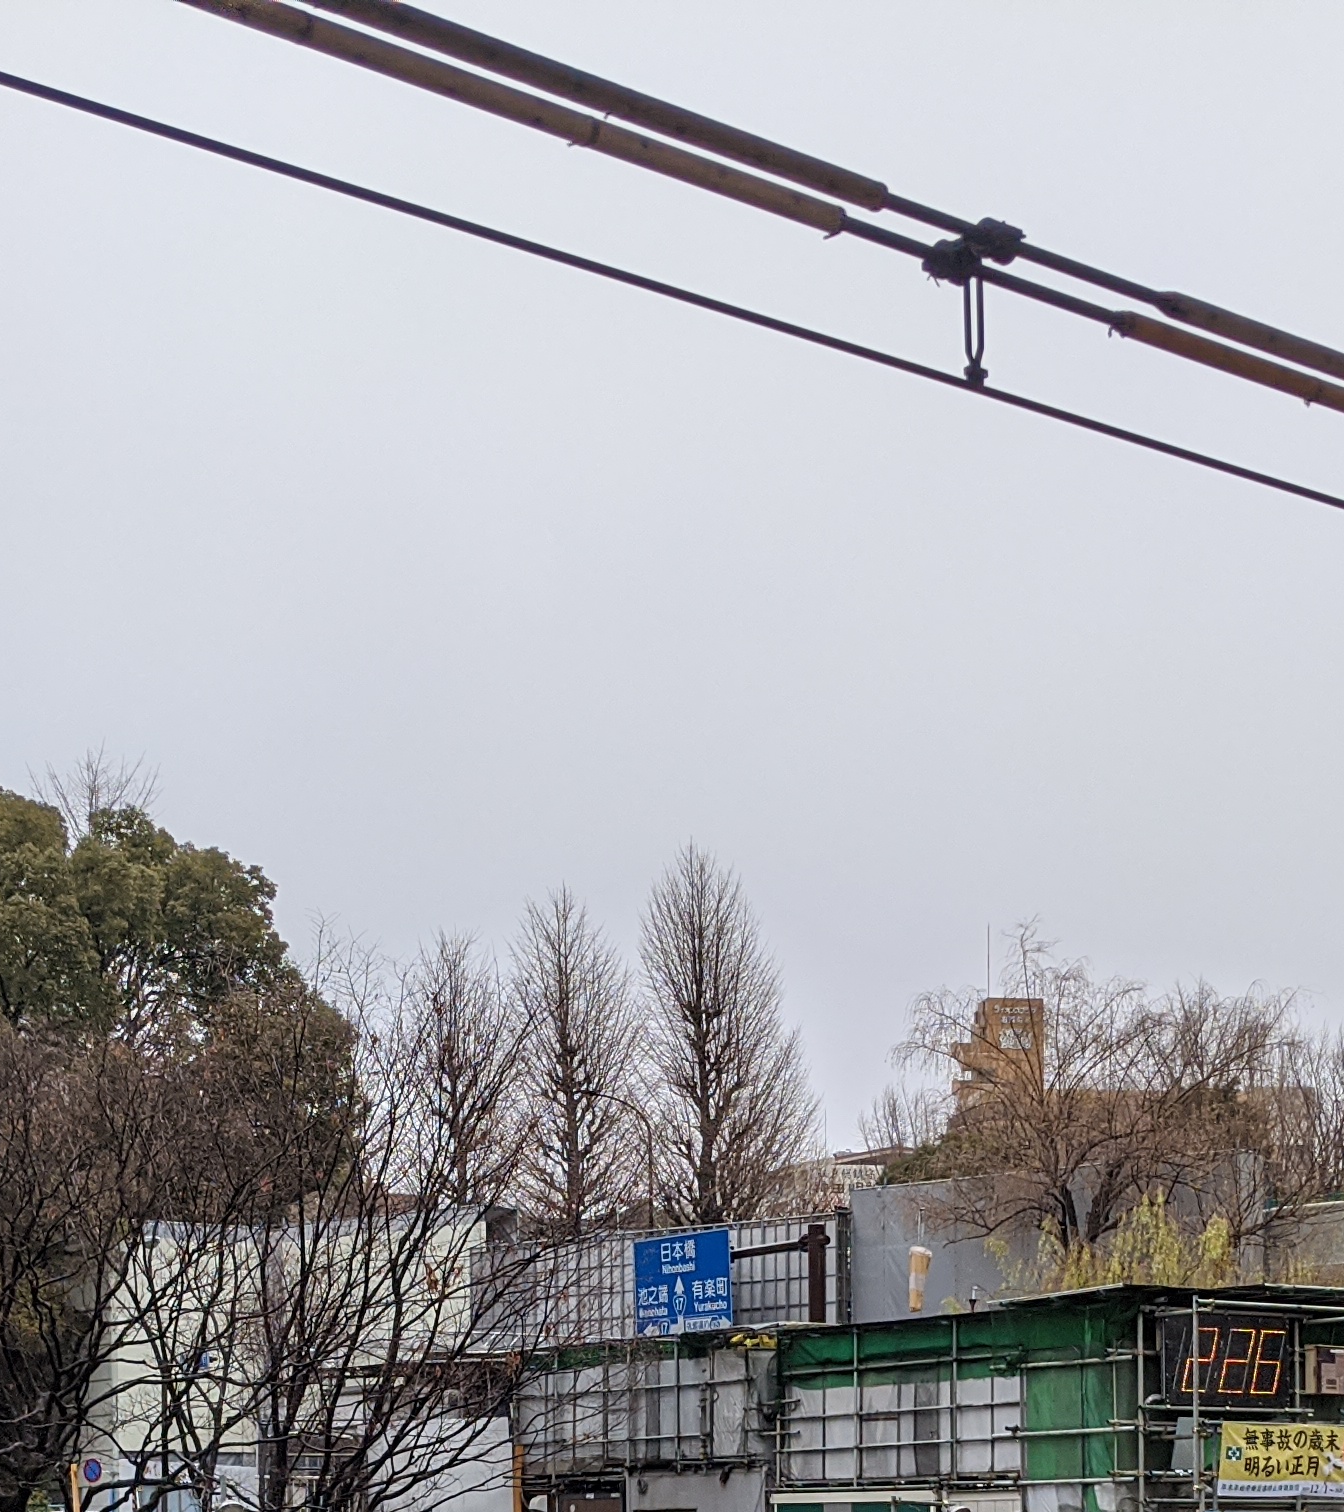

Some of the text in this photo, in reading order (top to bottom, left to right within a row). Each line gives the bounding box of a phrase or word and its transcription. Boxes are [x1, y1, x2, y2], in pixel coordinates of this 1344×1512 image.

[660, 1239, 696, 1263] 日本橋
[637, 1284, 669, 1306] 池之端
[691, 1277, 728, 1300] 有楽町
[675, 1298, 684, 1311] 17
[1181, 1327, 1286, 1394] 226
[1243, 1427, 1341, 1452] 無事故の歳末
[1244, 1455, 1320, 1478] 明るい正月
